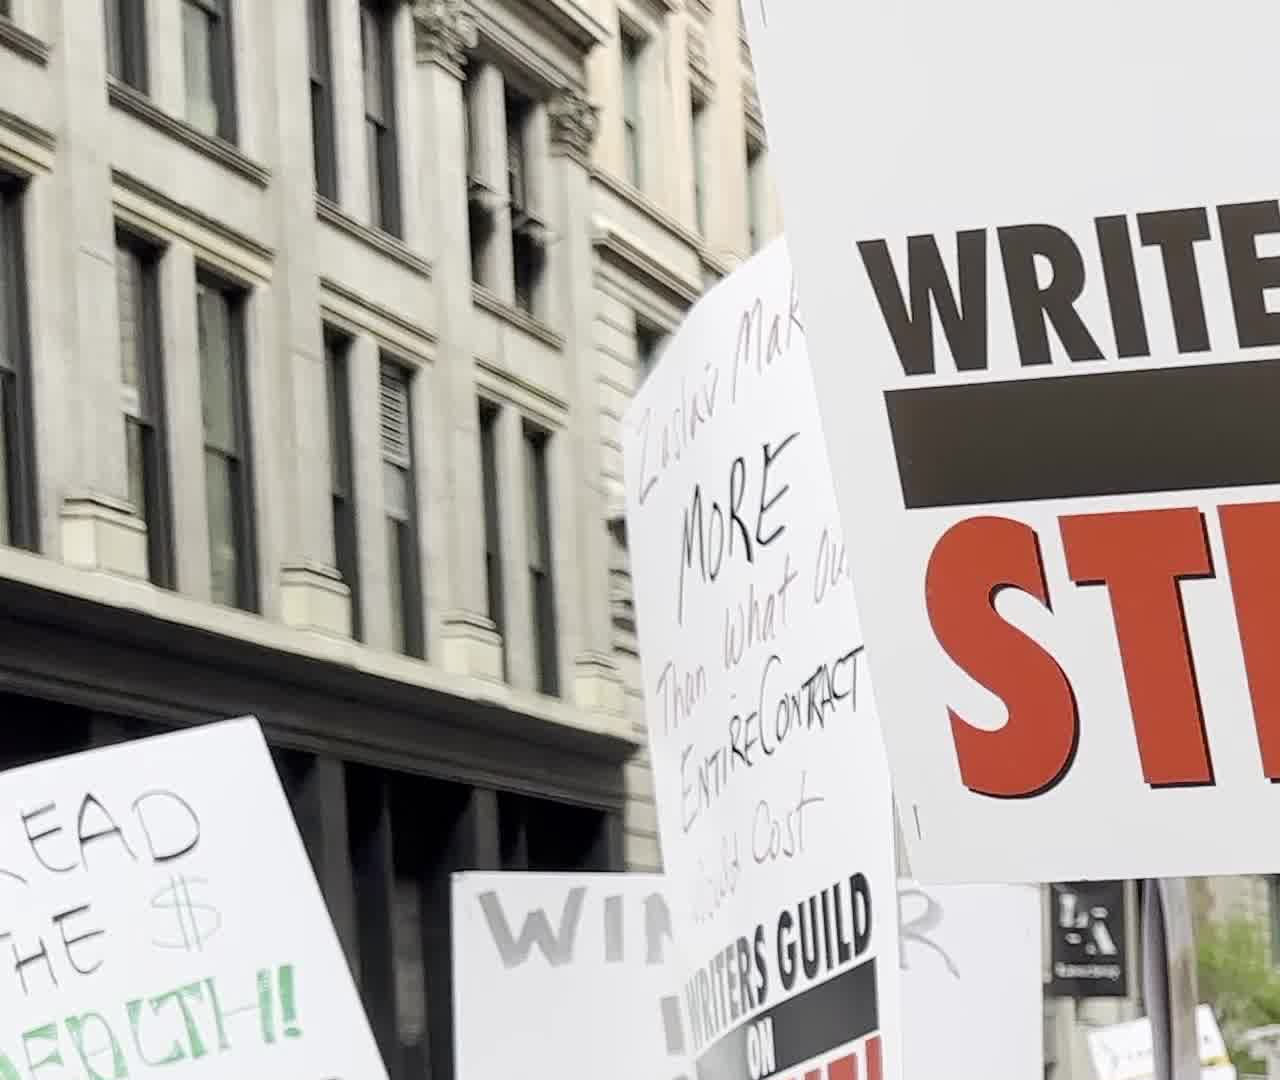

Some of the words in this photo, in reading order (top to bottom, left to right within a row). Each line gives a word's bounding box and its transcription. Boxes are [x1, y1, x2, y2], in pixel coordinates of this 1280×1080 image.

[679, 431, 801, 625] MORE
[0, 790, 200, 886] EAD
[0, 904, 104, 996] HE
[686, 922, 769, 1050] WRITERS
[776, 871, 873, 993] GUILD
